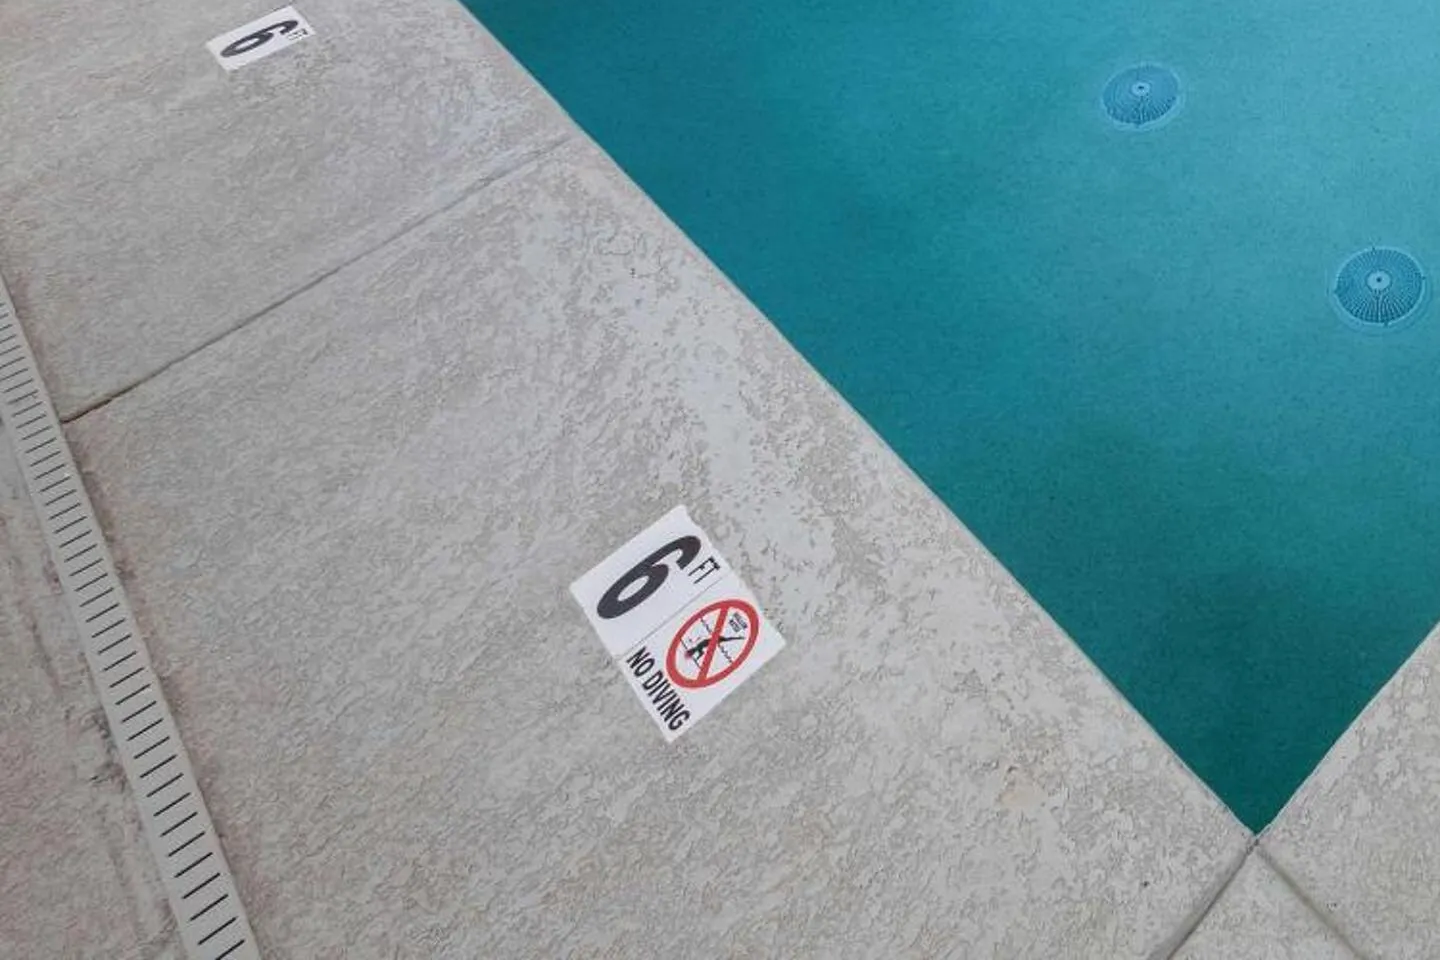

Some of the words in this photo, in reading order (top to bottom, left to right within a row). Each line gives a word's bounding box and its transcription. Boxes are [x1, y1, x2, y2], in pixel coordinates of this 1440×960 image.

[220, 20, 298, 57] 6
[596, 535, 701, 619] 6
[688, 556, 721, 585] FT
[626, 646, 656, 679] NO
[642, 671, 690, 731] DIVING
